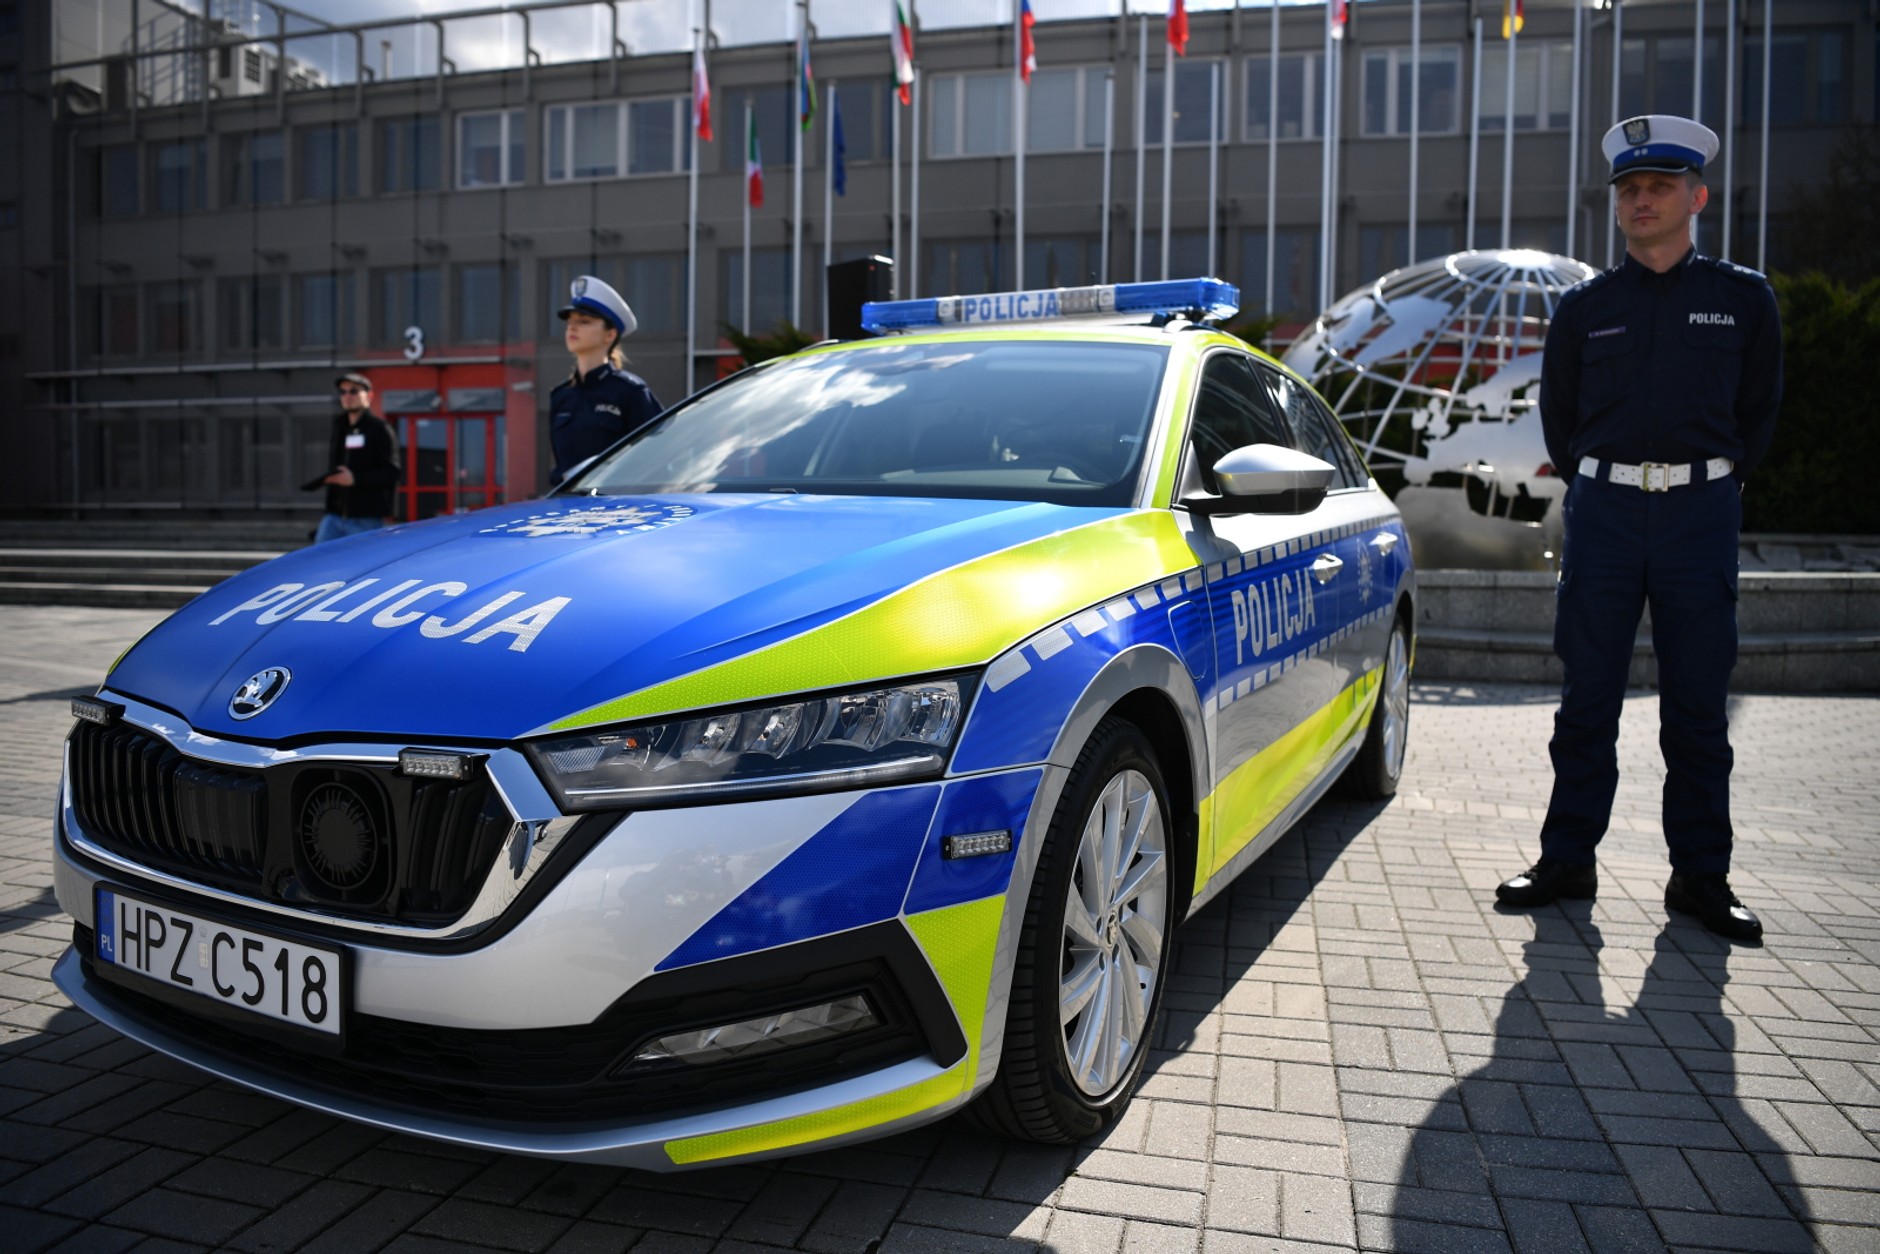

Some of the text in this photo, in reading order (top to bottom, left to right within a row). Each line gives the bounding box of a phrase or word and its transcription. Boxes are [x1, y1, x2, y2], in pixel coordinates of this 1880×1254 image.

[963, 290, 1059, 322] POLICJA
[1689, 312, 1735, 326] POLICJA
[403, 325, 425, 361] 3
[208, 579, 572, 652] POLICJA
[1231, 567, 1316, 665] POLICJA
[101, 933, 113, 952] PL
[121, 902, 328, 1024] HPZ C518
